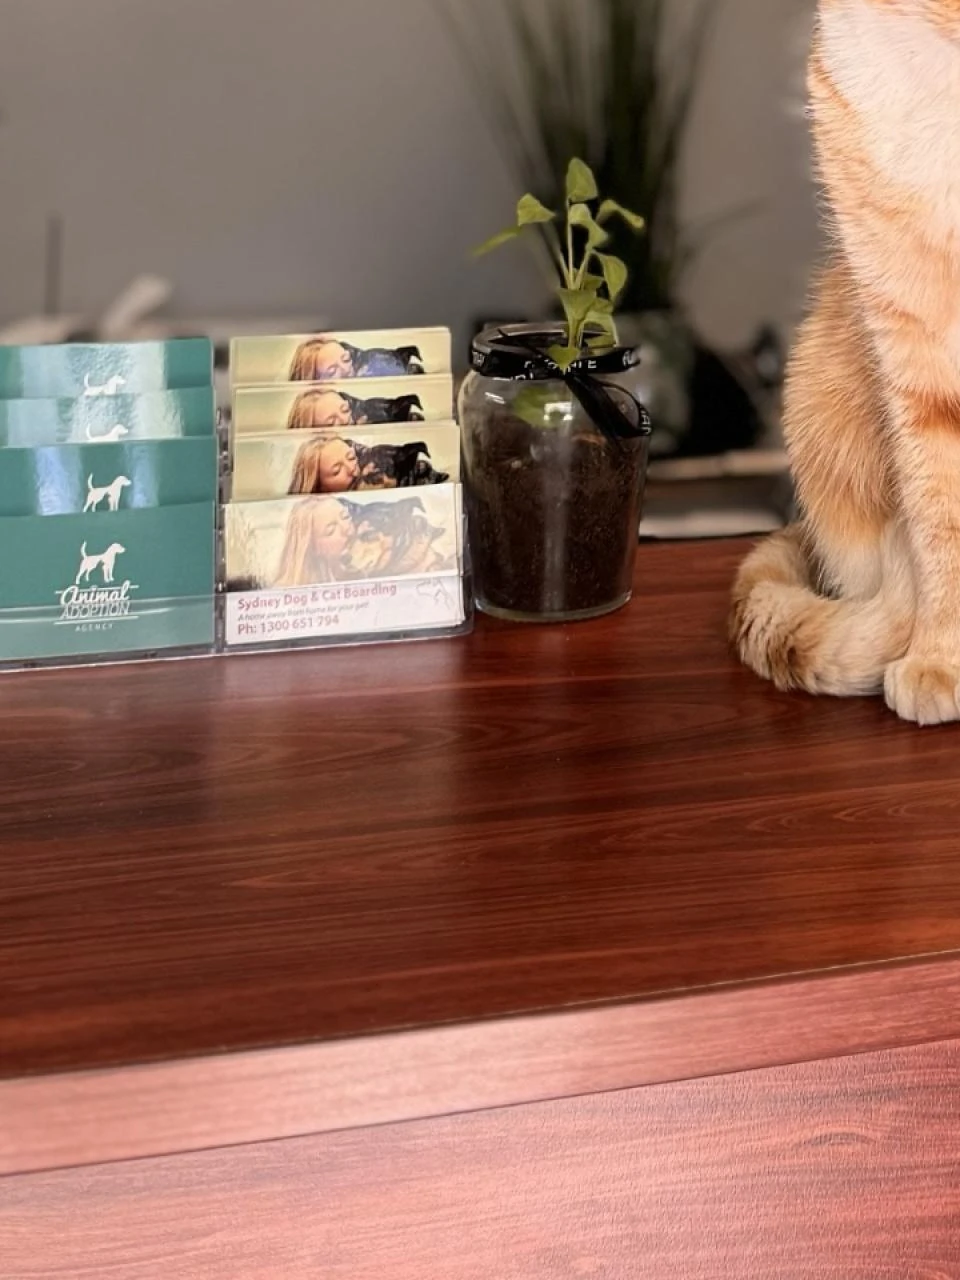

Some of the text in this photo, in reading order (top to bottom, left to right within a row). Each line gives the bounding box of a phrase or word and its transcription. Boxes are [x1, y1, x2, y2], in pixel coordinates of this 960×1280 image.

[61, 580, 131, 605] Animal
[238, 582, 397, 611] Sydney Dog & Cat Boarding
[61, 601, 130, 620] ADOPTION
[75, 623, 113, 632] AGENCY
[238, 614, 339, 635] Ph: 1300 651 794
